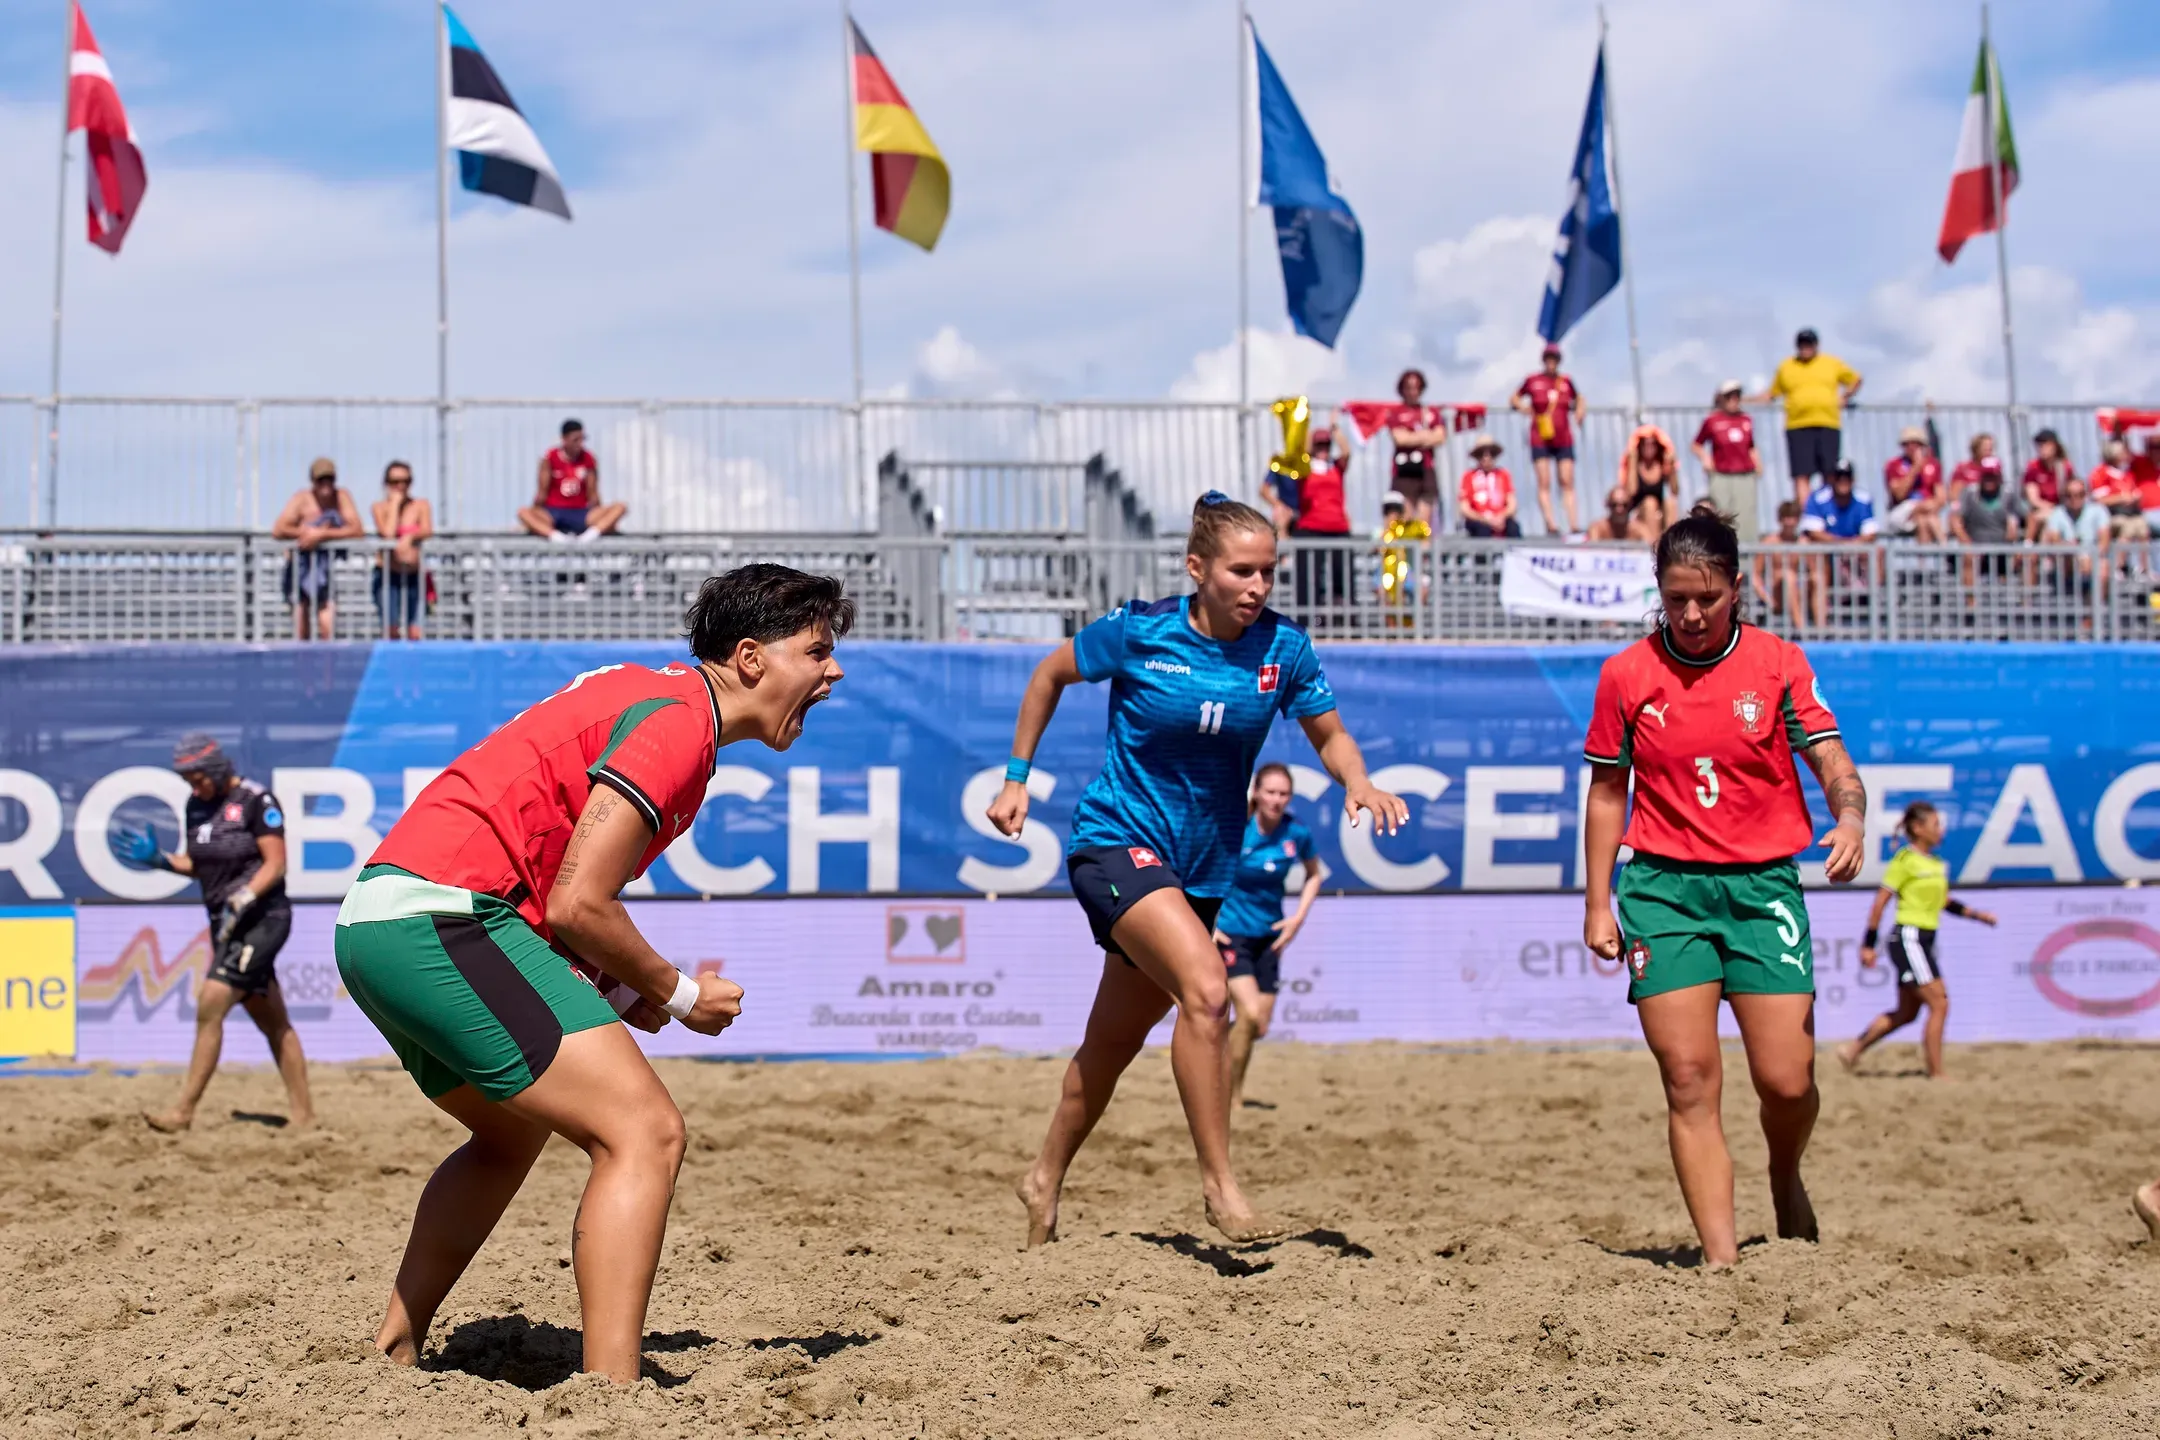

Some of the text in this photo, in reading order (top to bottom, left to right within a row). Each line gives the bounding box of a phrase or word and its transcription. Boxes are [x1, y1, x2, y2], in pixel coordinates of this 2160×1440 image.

[1145, 660, 1191, 676] uhlsport
[1198, 700, 1225, 736] 11
[1695, 757, 1719, 808] 3
[1766, 900, 1799, 948] 3
[857, 976, 996, 997] Amaro
